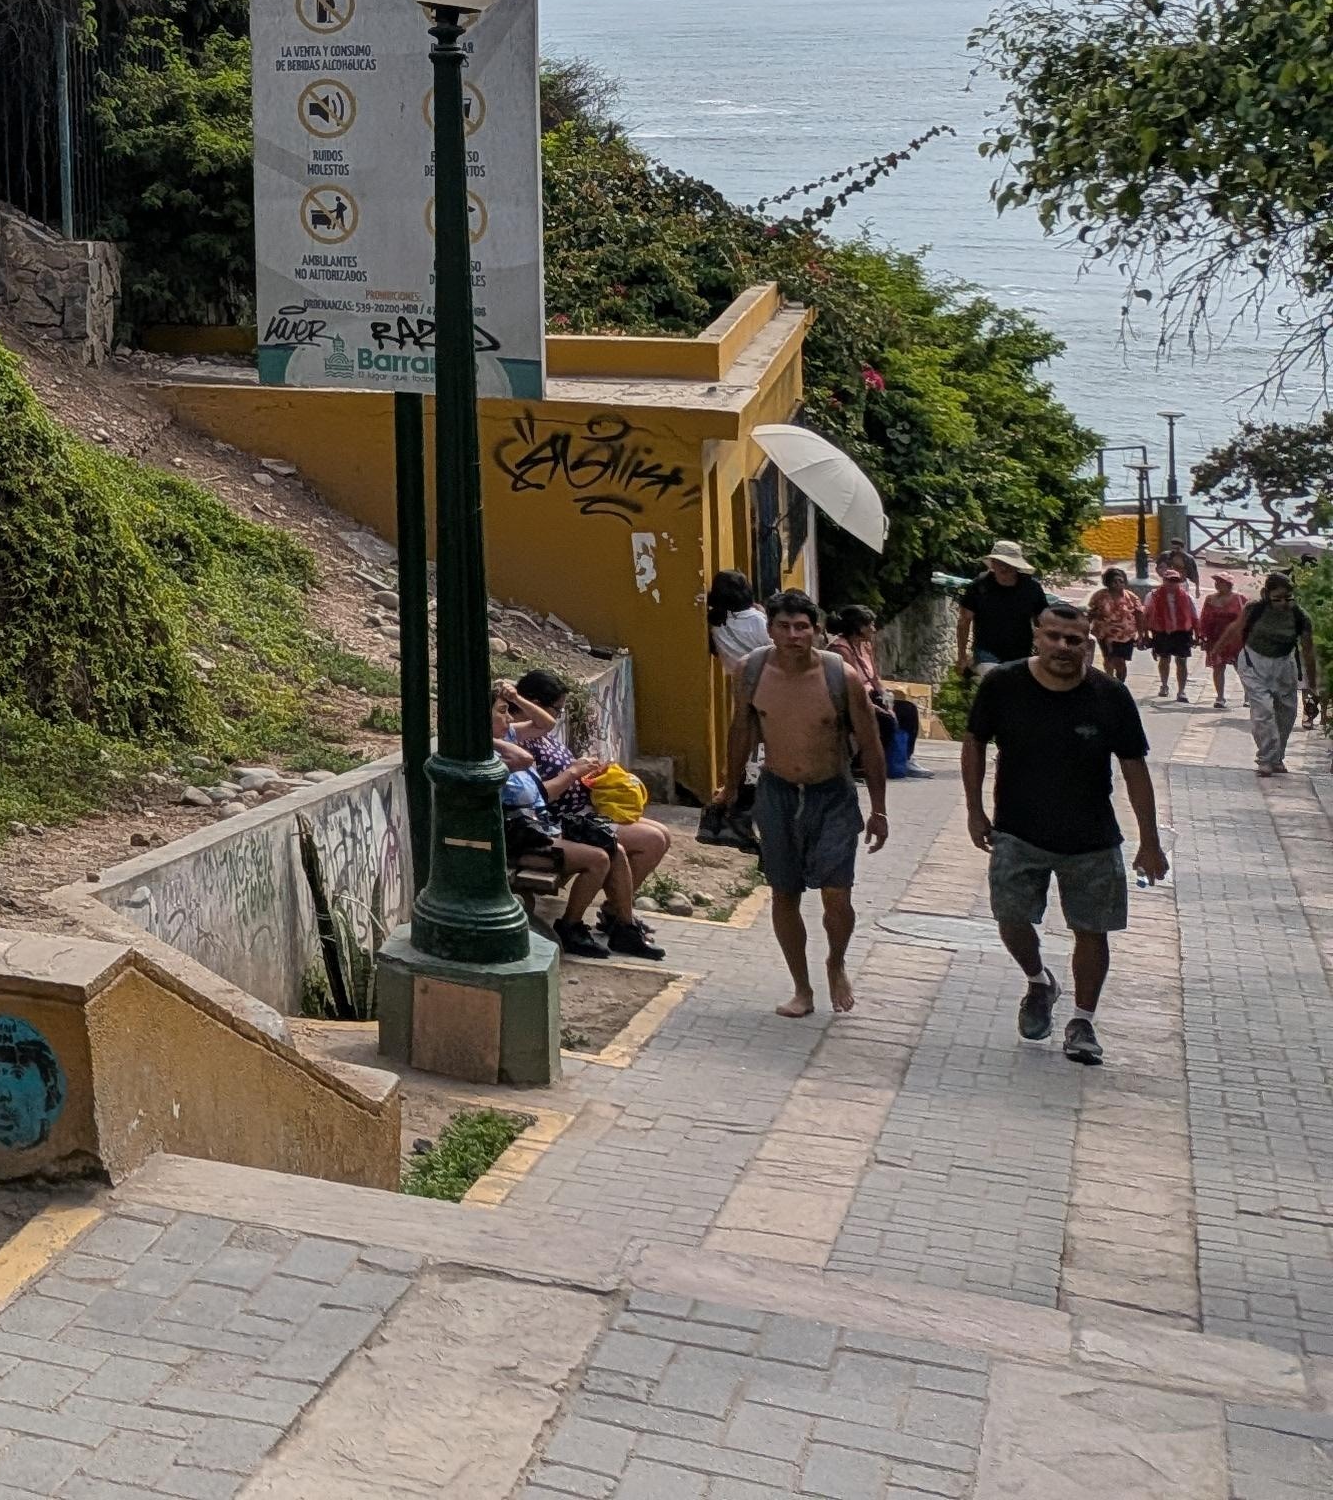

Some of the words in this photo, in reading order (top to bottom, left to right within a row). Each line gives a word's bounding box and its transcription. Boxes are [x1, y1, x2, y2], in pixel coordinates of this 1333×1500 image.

[281, 47, 292, 57] LA
[294, 46, 321, 57] VENTA
[323, 46, 329, 56] Y
[330, 45, 371, 56] CONSUMO
[276, 60, 286, 71] DE
[287, 60, 320, 71] BEBIDAS
[313, 150, 343, 161] RUIDOS
[307, 164, 350, 176] MOLESTOS
[301, 255, 358, 268] AMBULANTES
[294, 268, 308, 280] NO
[309, 268, 368, 282] AUTORIZADOS
[358, 347, 436, 374] Barra
